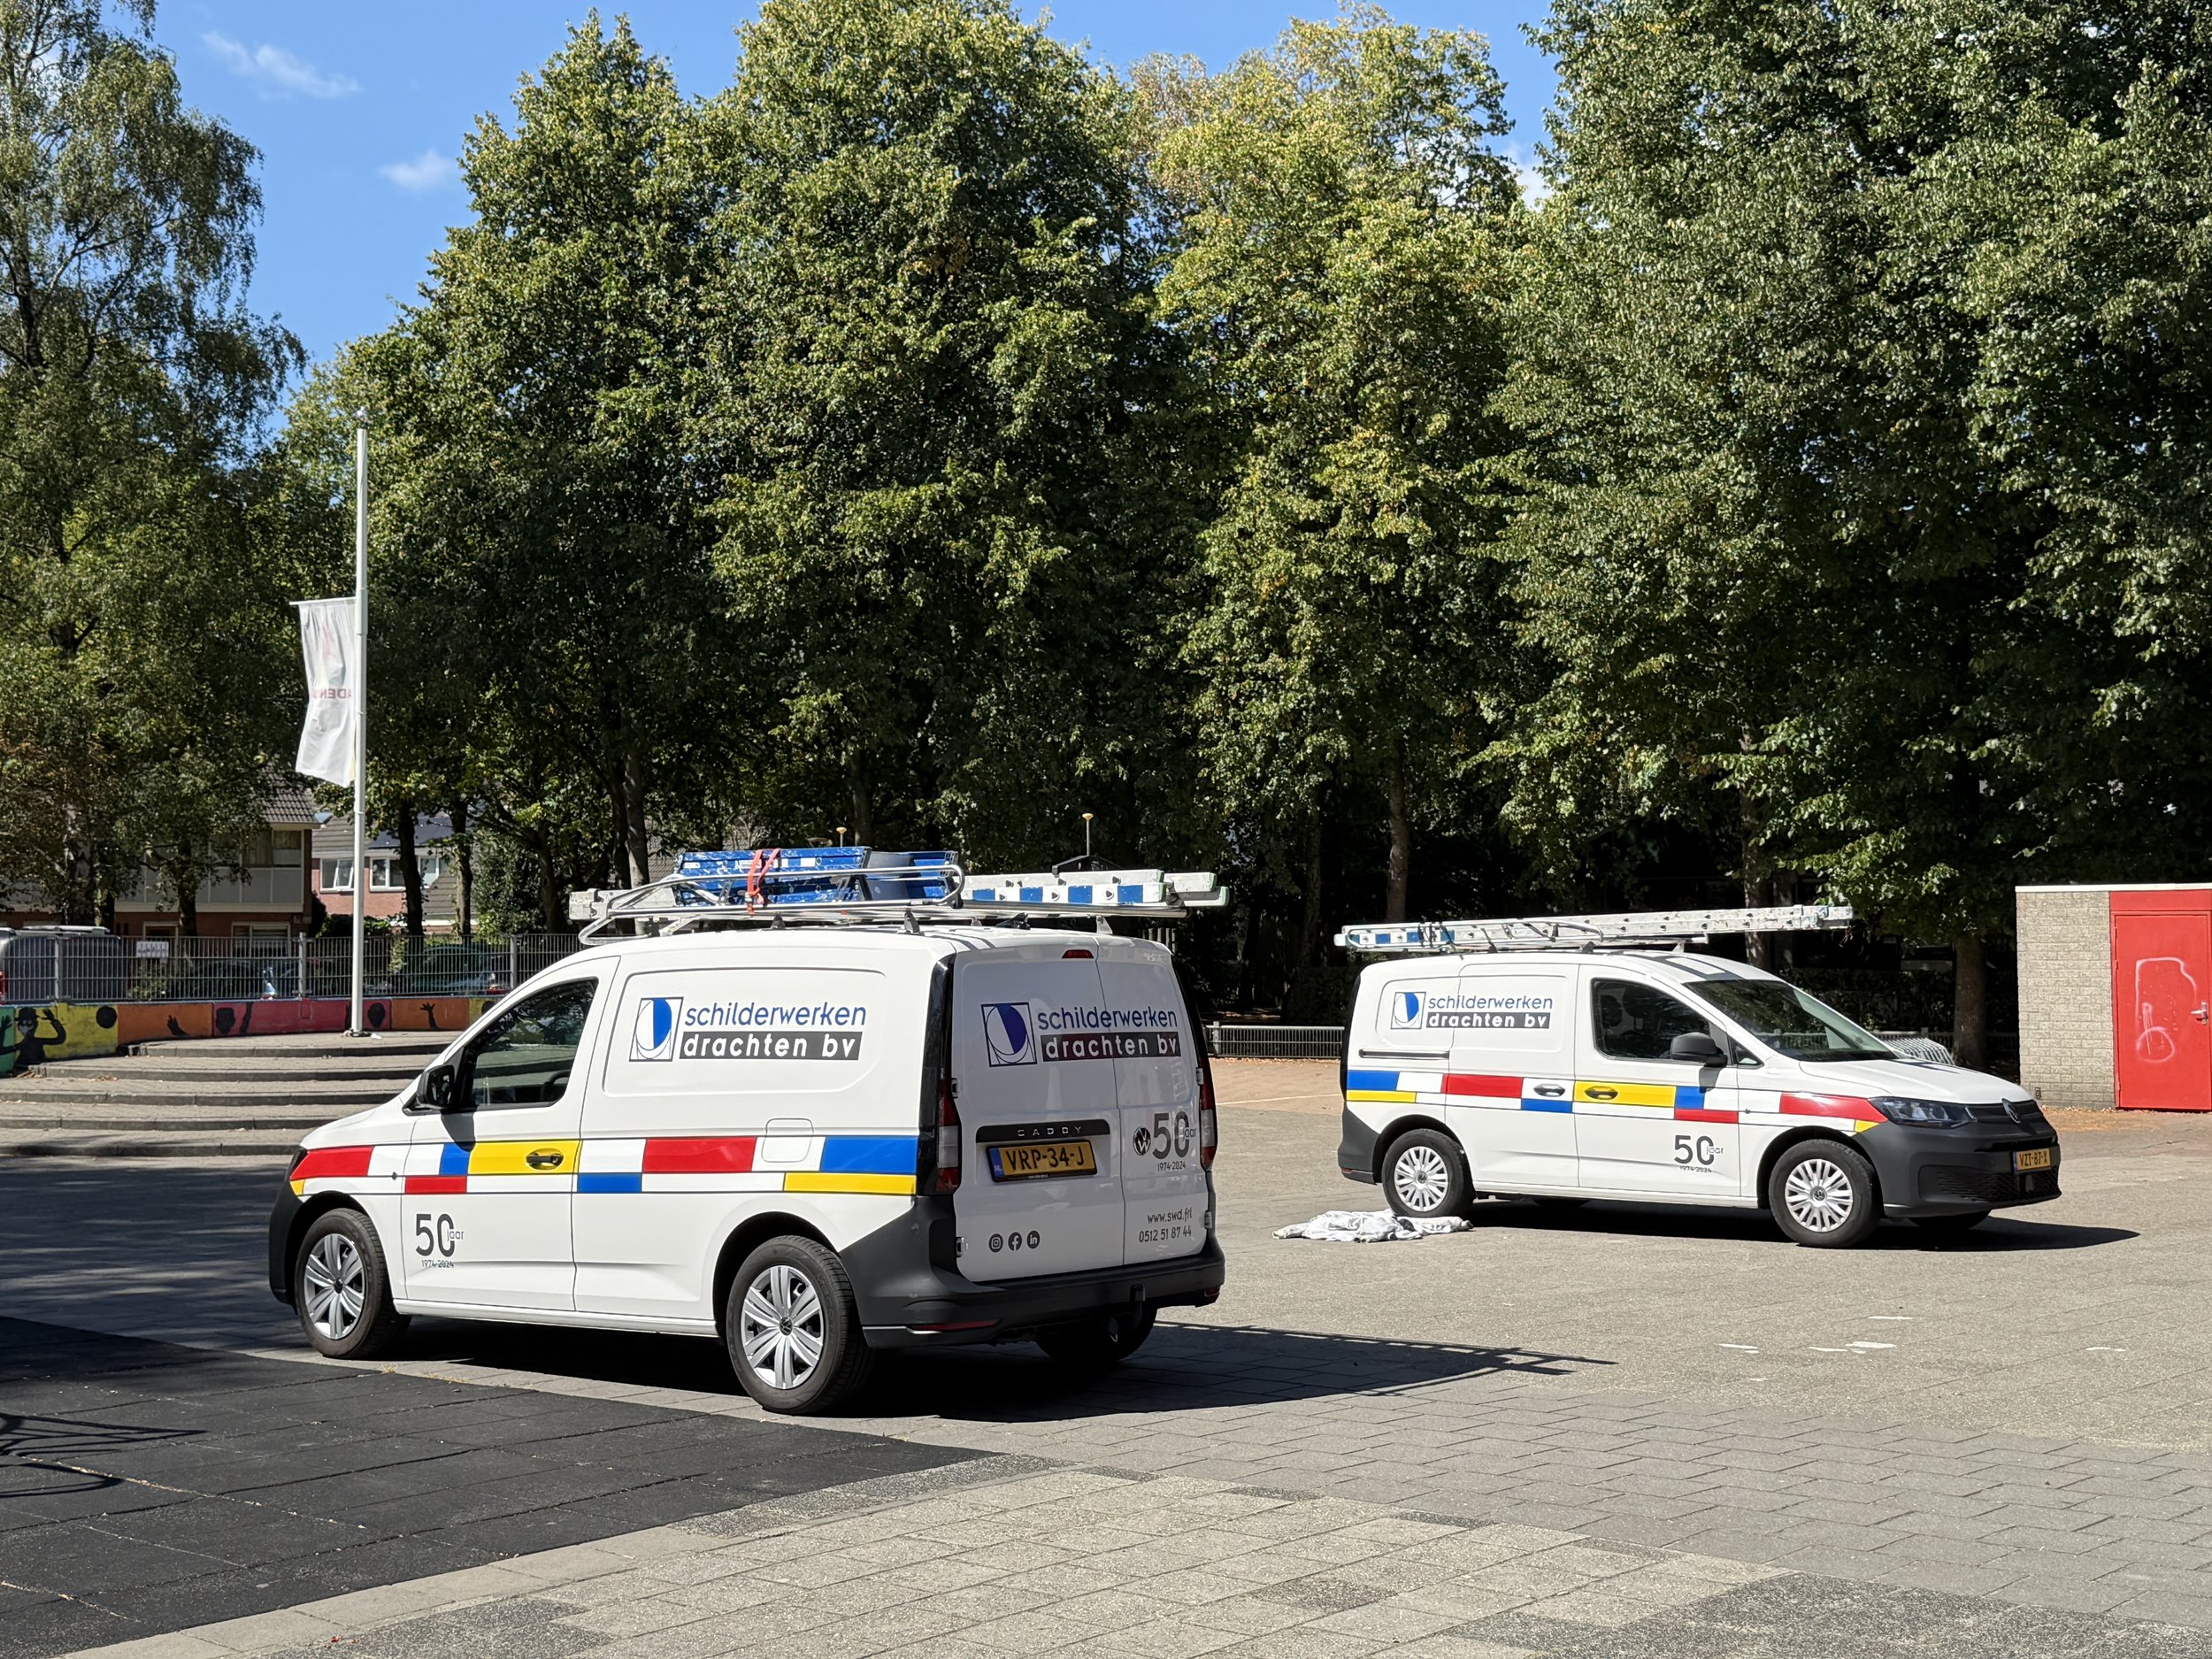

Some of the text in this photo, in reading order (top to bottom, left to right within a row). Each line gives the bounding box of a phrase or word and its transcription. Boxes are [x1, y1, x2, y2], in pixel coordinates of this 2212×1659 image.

[684, 1002, 867, 1026] schilderwerken
[1428, 995, 1553, 1010] schilderwerken
[1038, 1006, 1178, 1030] schilderwerken
[1428, 1012, 1547, 1027] drachten bv
[683, 1033, 856, 1057] drachten bv
[1045, 1033, 1177, 1058] drachten bv
[1018, 1126, 1081, 1137] CADDY
[1152, 1111, 1189, 1159] 50
[1005, 1147, 1085, 1171] VRP-34-J
[1674, 1134, 1714, 1165] 50
[1157, 1161, 1187, 1171] 1974-2024
[1147, 1207, 1193, 1223] www.swd.frl
[416, 1213, 455, 1257] 50
[1139, 1229, 1158, 1243] 0512
[1160, 1228, 1169, 1240] 51
[1171, 1226, 1181, 1239] 87
